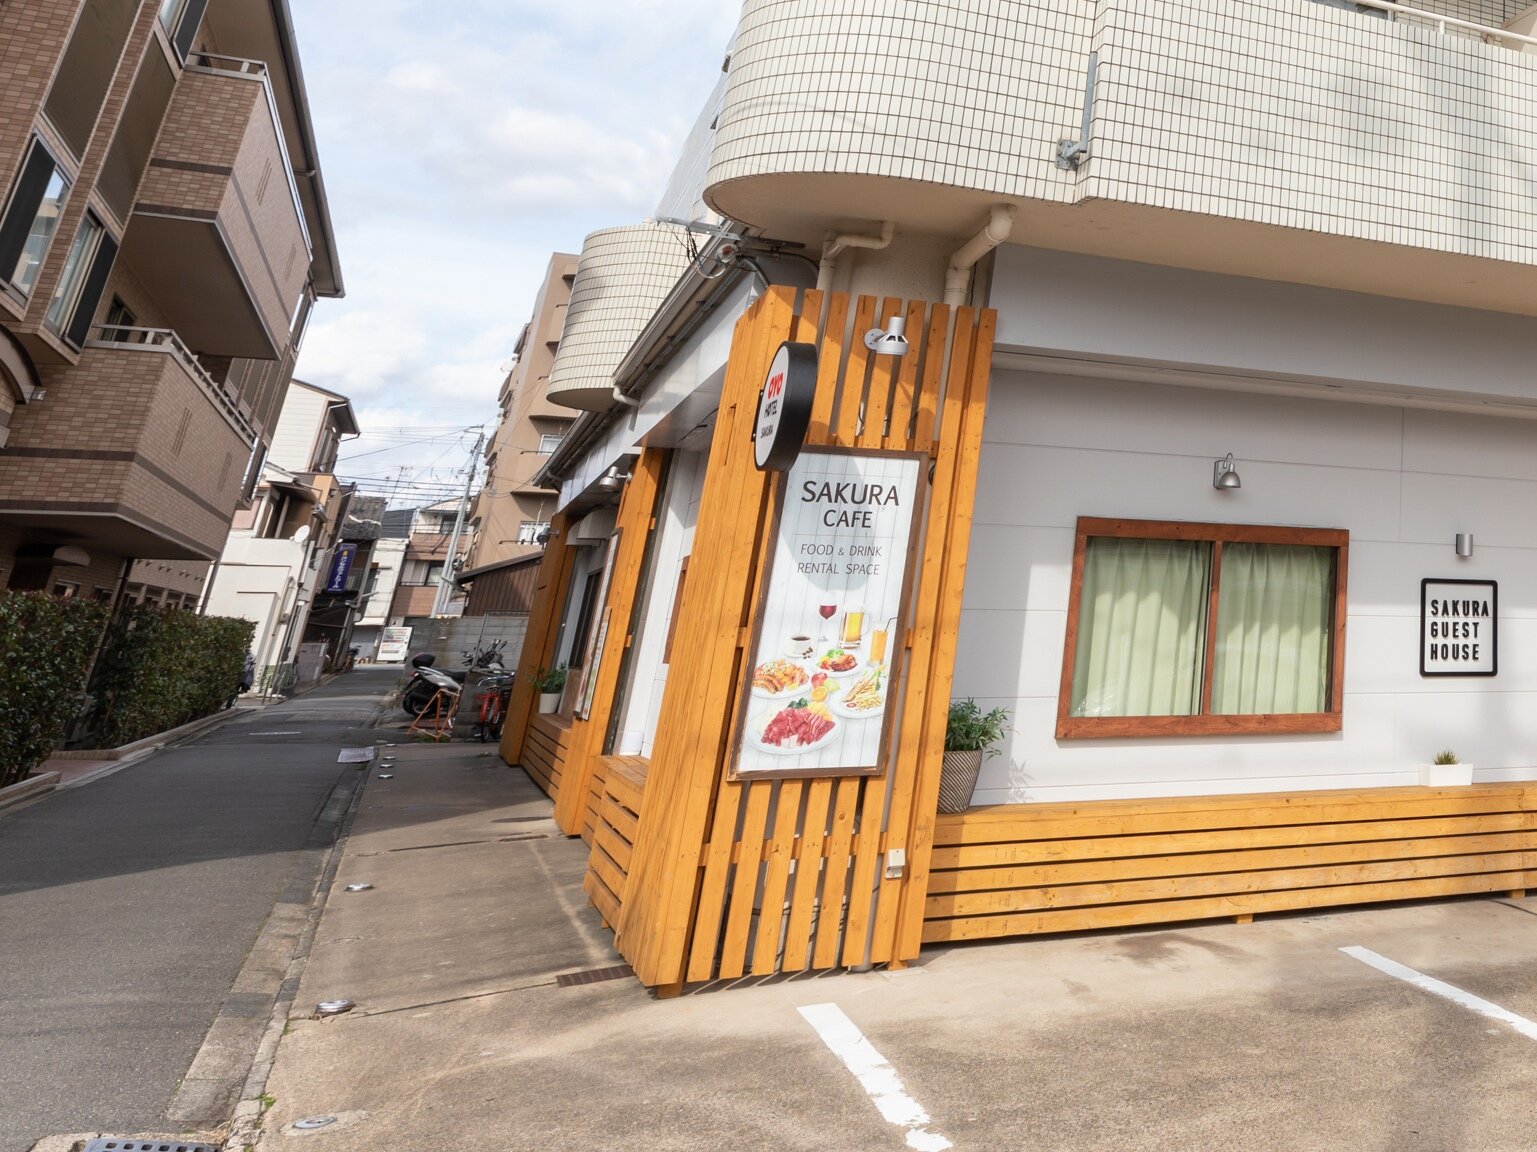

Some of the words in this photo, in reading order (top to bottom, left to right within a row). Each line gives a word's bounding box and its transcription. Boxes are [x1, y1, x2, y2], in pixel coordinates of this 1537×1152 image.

[768, 373, 783, 399] OYO
[801, 480, 899, 506] SAKURA
[823, 509, 873, 528] CAFE
[800, 544, 833, 556] FOOD
[838, 547, 845, 556] &
[849, 545, 882, 557] DRINK
[797, 563, 839, 575] RENTAL
[845, 563, 880, 575] SPACE
[1431, 599, 1489, 617] SAKURA
[1431, 621, 1479, 639] GUEST
[1430, 643, 1479, 660] HOUSE
